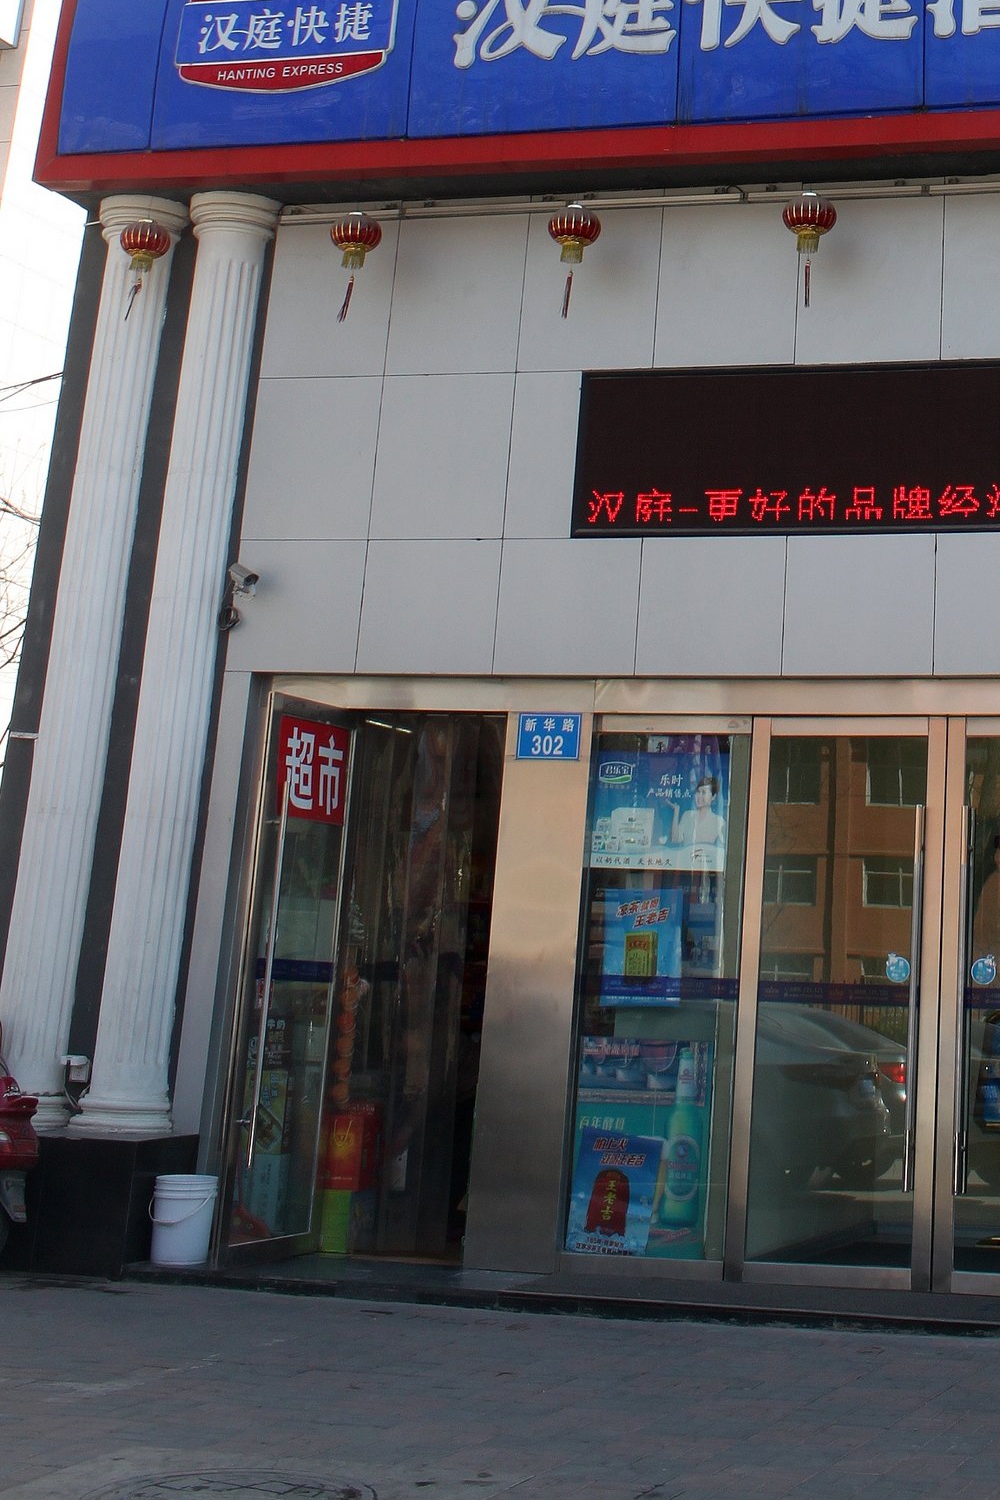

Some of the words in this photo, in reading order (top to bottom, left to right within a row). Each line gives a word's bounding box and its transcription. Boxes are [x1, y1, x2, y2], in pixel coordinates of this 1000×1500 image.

[198, 2, 373, 54] 汉庭快捷
[217, 67, 276, 81] HANTING
[282, 62, 343, 77] EXPRESS
[525, 718, 575, 732] 新华路
[531, 735, 564, 755] 302
[285, 726, 344, 816] 超市
[601, 1180, 617, 1221] 王老吉
